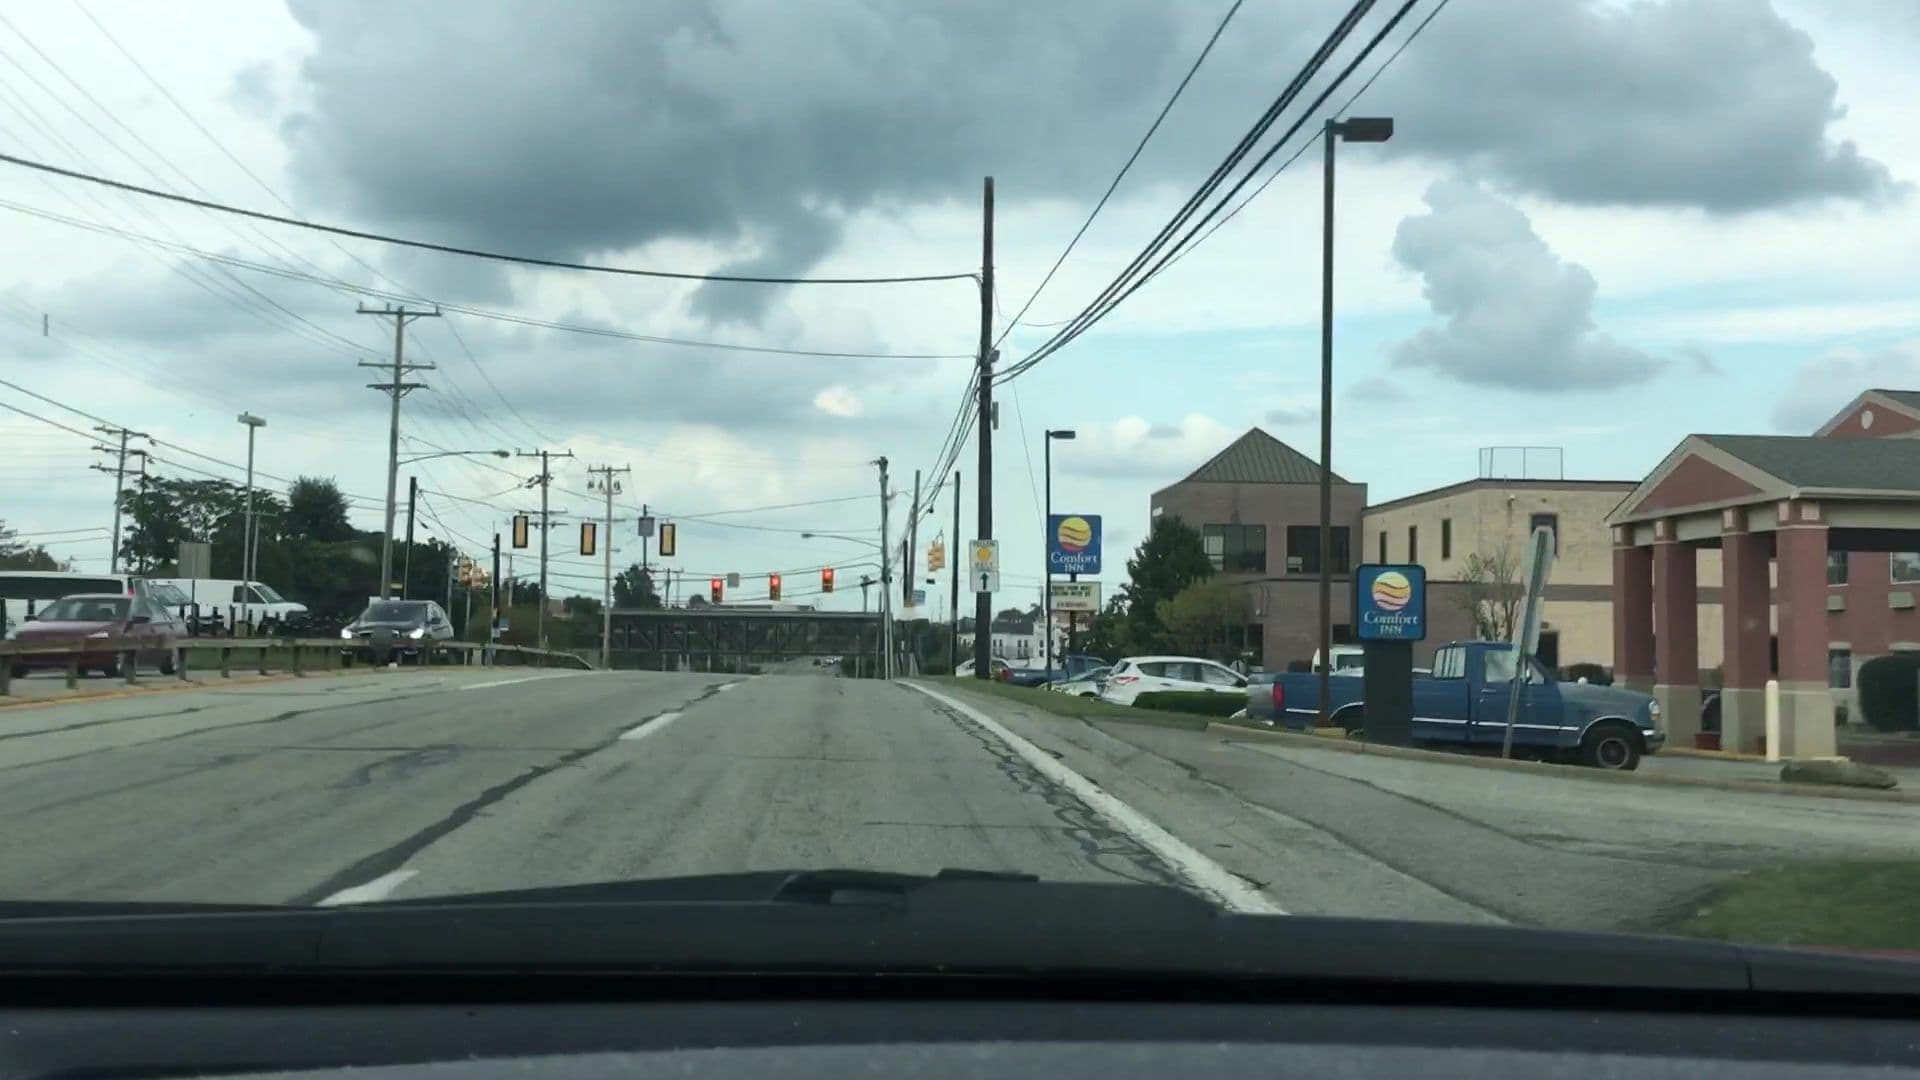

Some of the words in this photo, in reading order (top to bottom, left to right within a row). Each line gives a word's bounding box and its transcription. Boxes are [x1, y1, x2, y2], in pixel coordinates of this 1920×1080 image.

[1051, 552, 1097, 564] Comfort
[1064, 563, 1084, 573] INN
[1364, 611, 1418, 624] Comfort
[1380, 625, 1403, 635] INN
